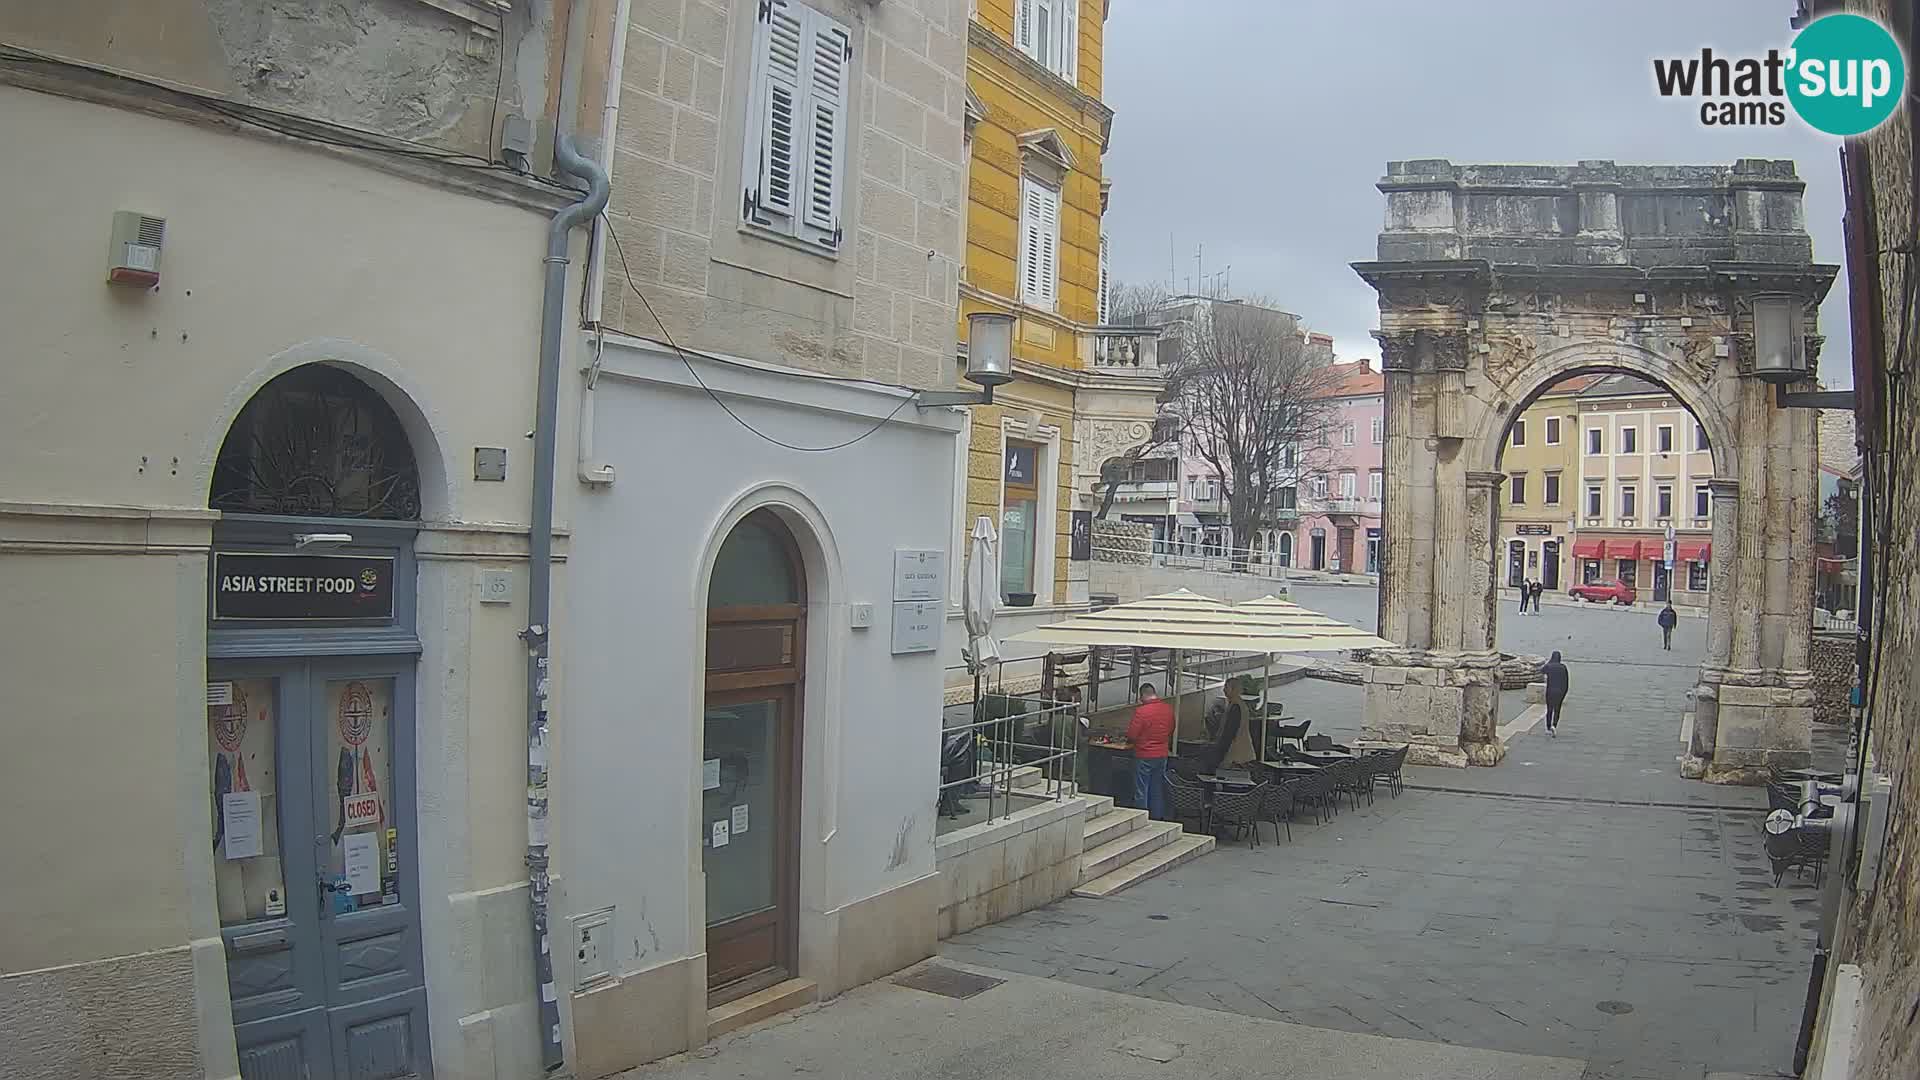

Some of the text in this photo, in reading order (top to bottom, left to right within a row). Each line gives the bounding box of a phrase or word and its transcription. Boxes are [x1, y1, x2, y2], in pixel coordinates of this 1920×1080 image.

[222, 575, 355, 593] ASIA STREET FOOD
[349, 800, 376, 819] CLOSED
